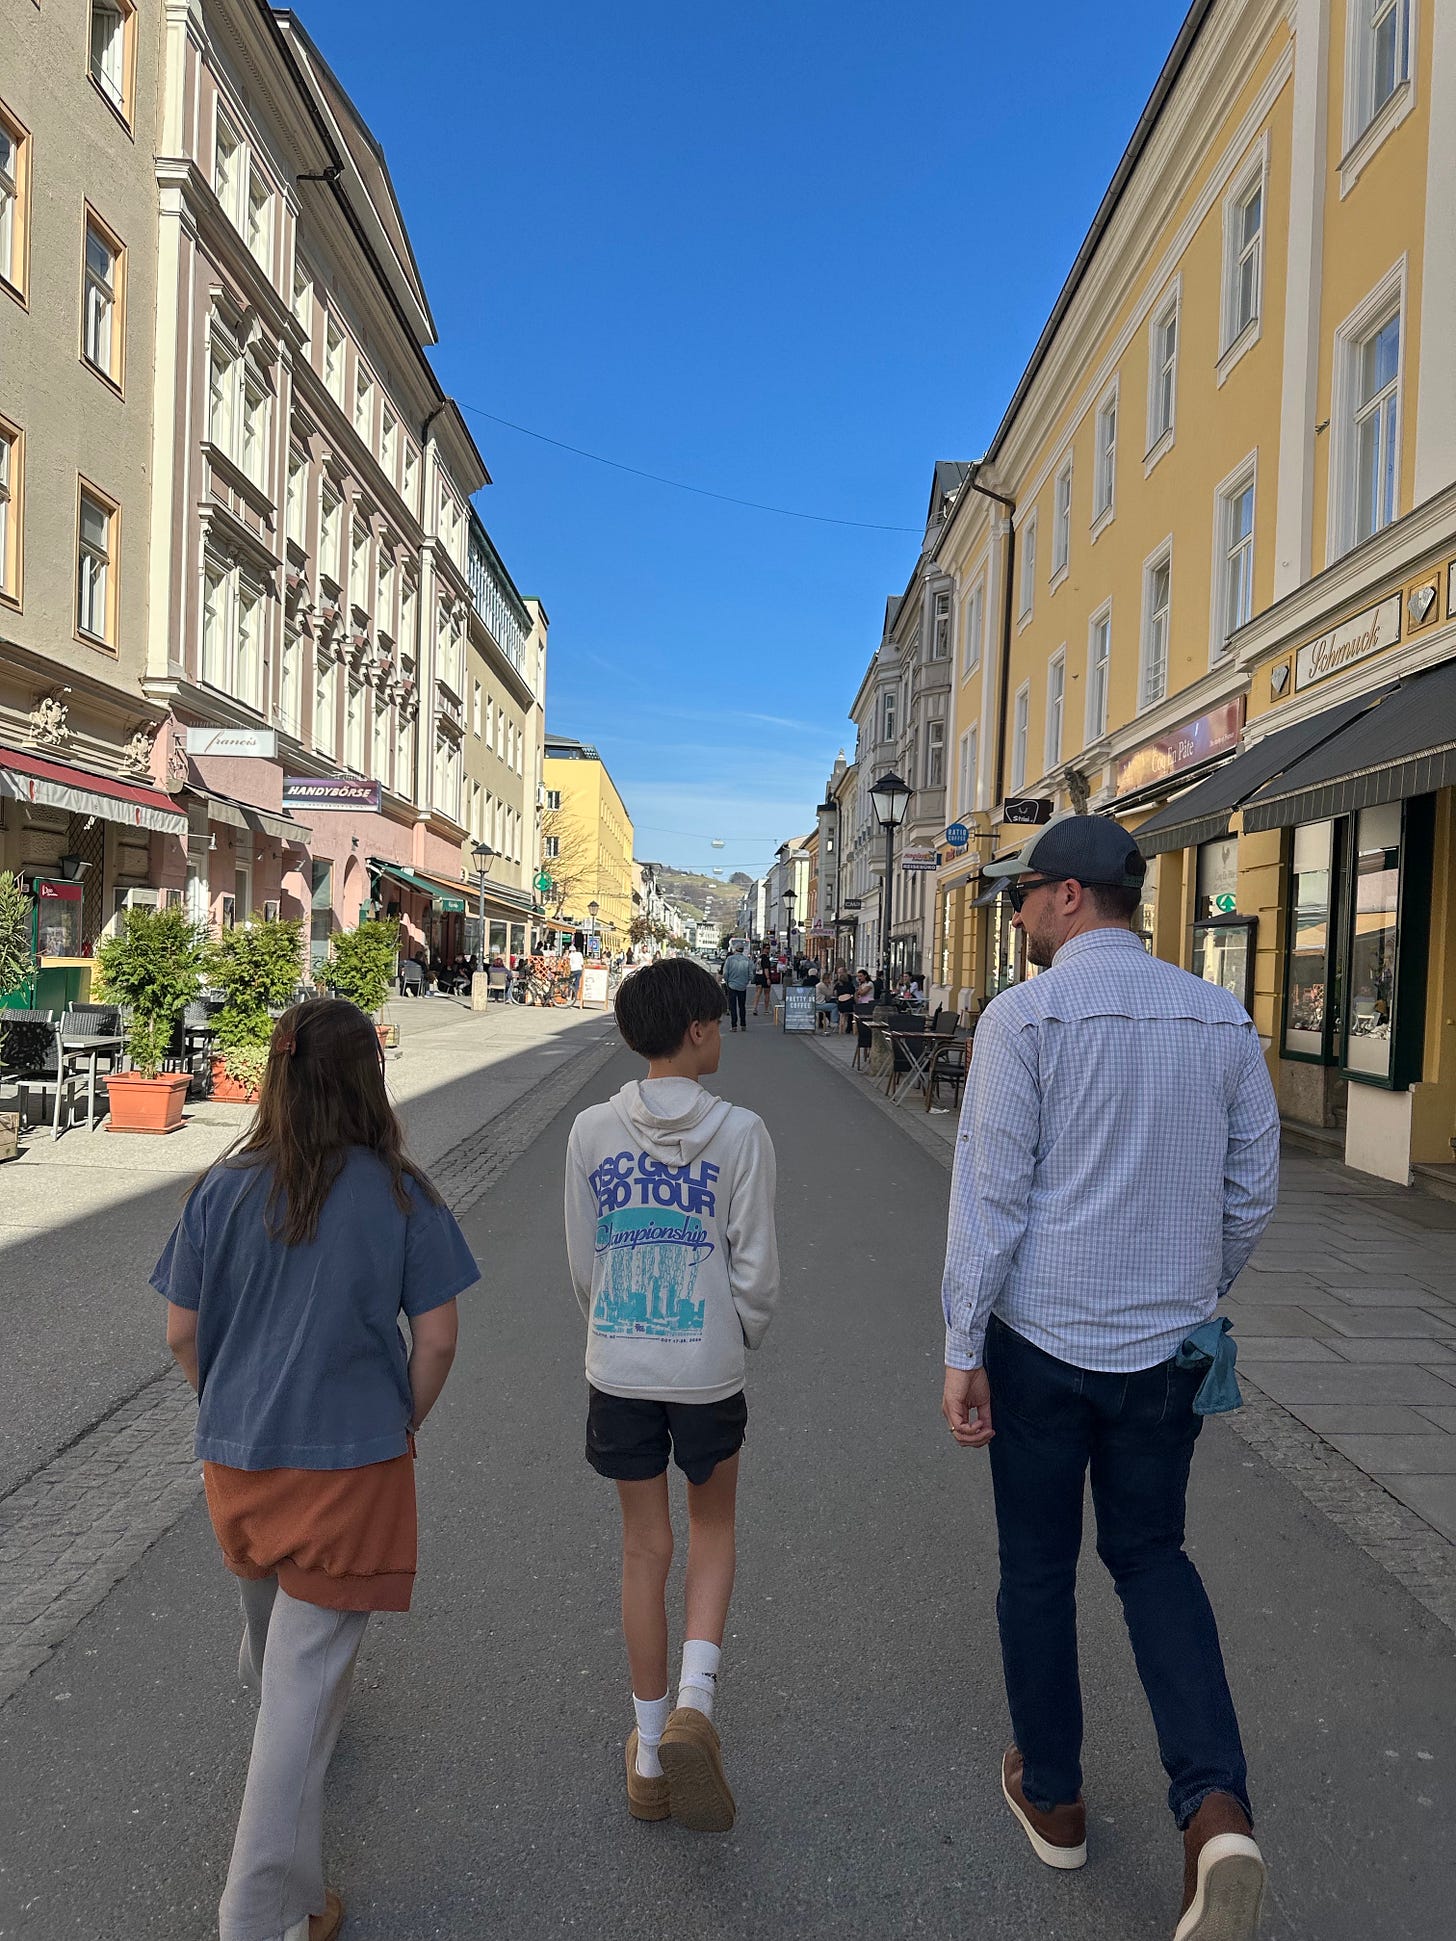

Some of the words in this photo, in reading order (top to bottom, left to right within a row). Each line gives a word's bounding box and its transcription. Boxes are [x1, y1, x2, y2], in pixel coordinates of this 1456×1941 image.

[1308, 608, 1380, 679] Schmuck
[203, 730, 258, 753] francis
[1167, 746, 1177, 767] En
[1178, 738, 1194, 762] Pâte
[287, 785, 371, 798] HANDYBÖRSE
[948, 828, 966, 836] RATIO
[638, 1151, 720, 1189] GOLF
[634, 1177, 716, 1218] TOUR
